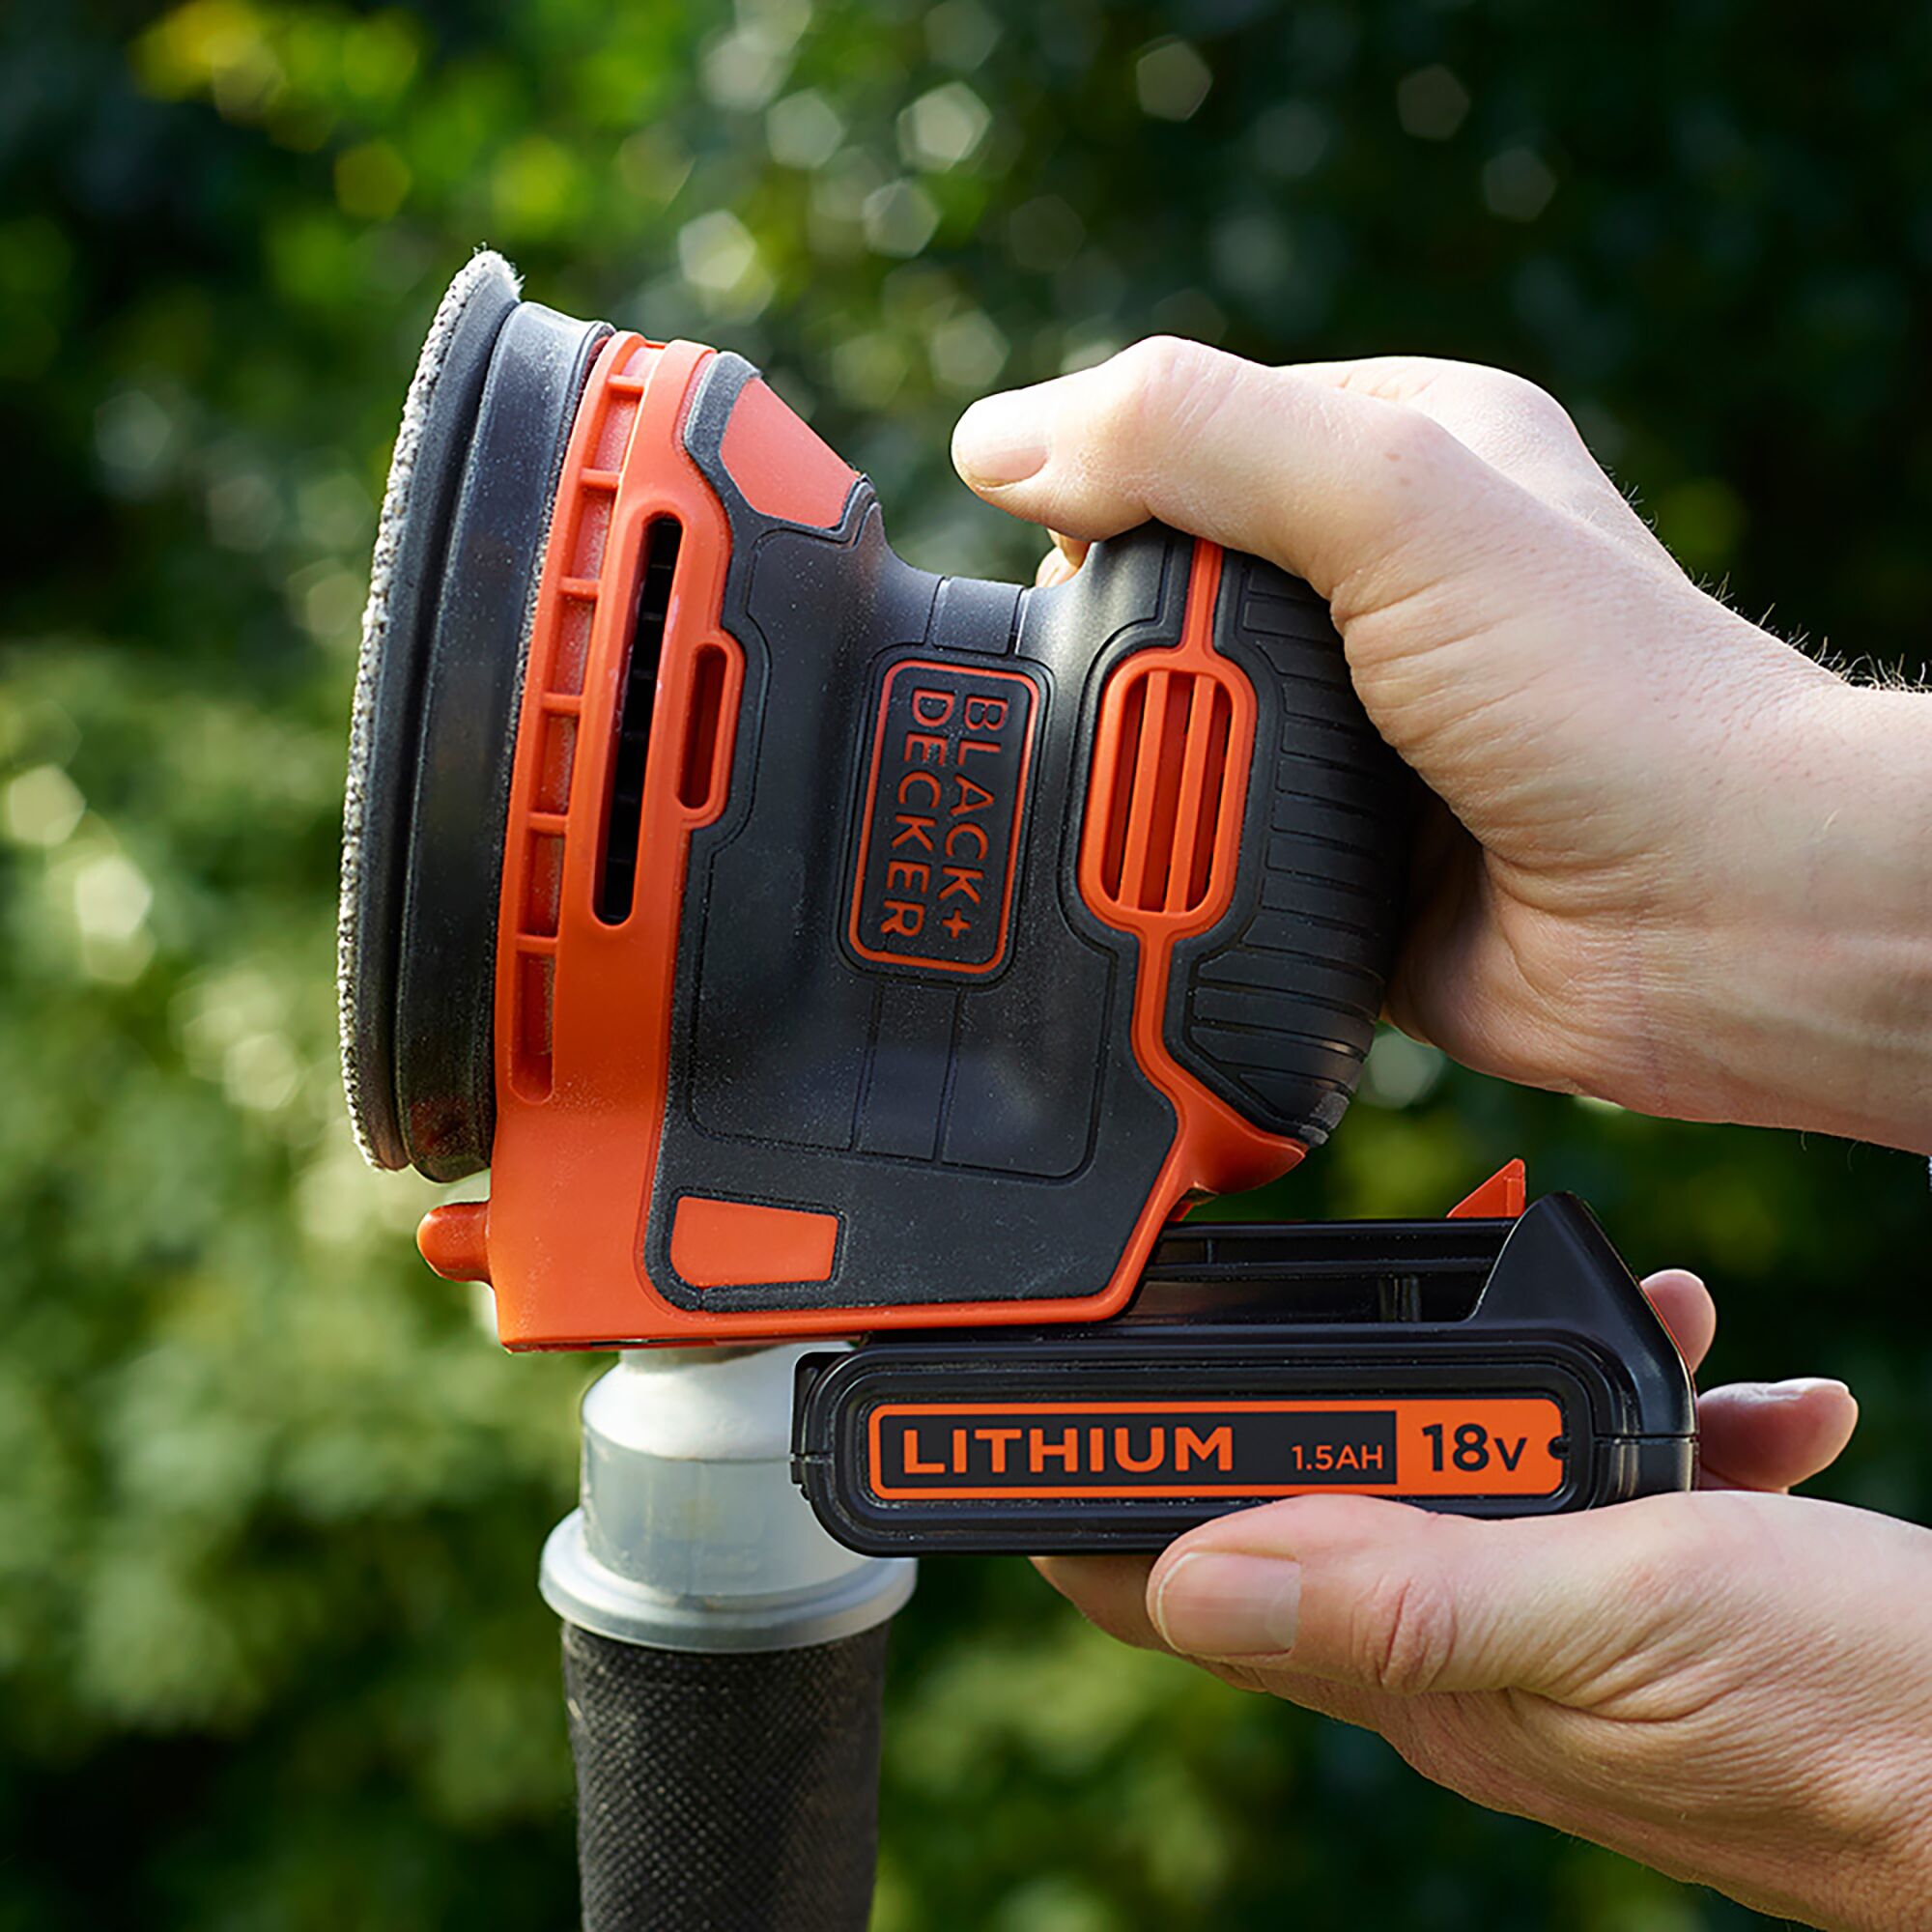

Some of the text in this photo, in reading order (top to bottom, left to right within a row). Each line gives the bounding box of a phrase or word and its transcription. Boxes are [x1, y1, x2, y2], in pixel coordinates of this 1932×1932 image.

[880, 687, 956, 938] DECKER
[937, 695, 1009, 940] BLACK+
[902, 1426, 1234, 1475] LITHIUM
[1292, 1443, 1384, 1472] 1.5AH
